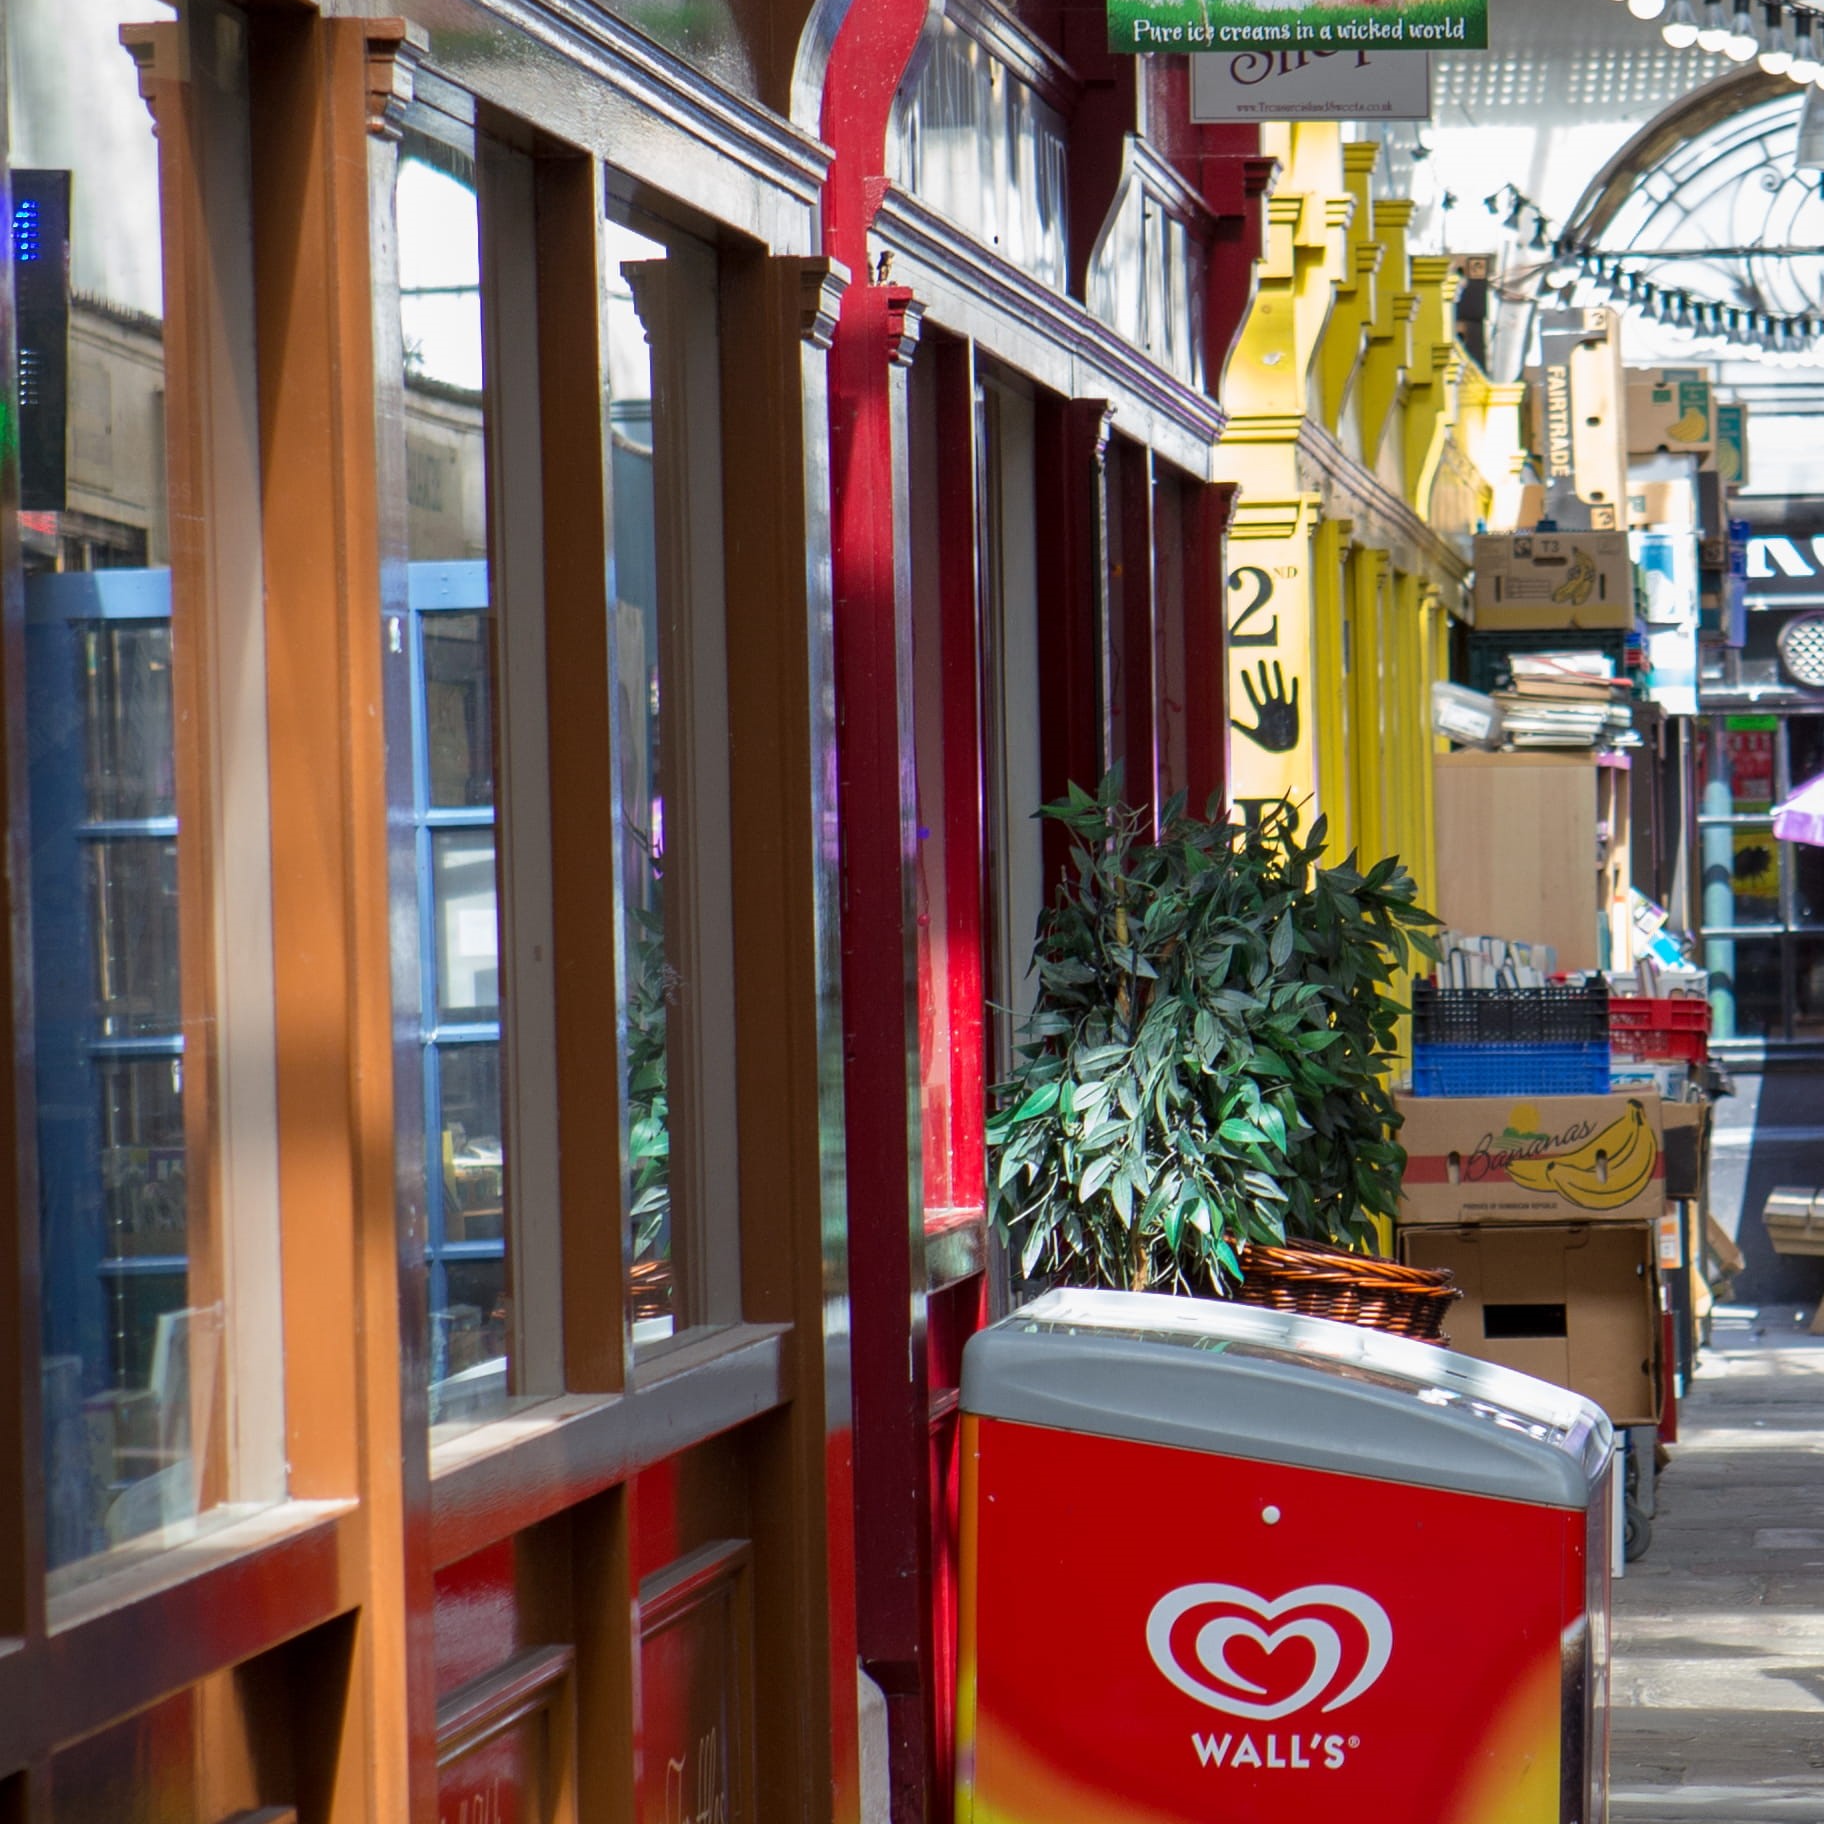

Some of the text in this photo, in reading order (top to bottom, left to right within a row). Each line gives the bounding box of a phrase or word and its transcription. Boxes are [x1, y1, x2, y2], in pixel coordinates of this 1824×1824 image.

[1133, 17, 1466, 43] Pure ice creams in a wicked world
[1546, 364, 1570, 477] FAIRTRADE
[1464, 1119, 1598, 1183] Bananas
